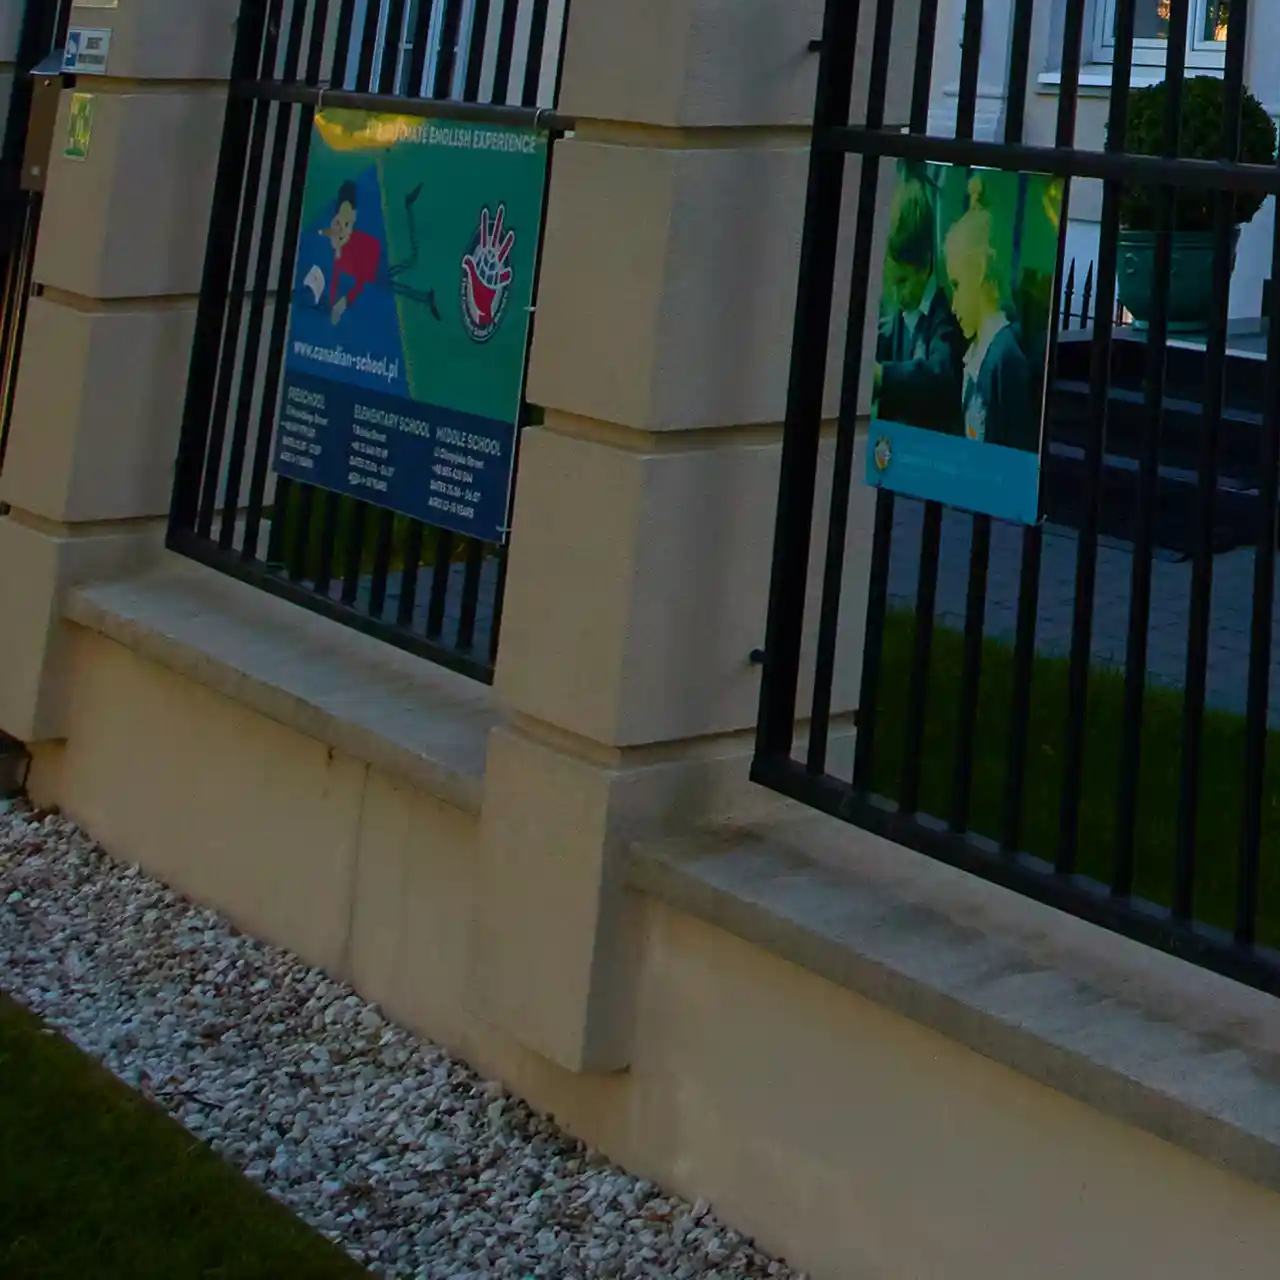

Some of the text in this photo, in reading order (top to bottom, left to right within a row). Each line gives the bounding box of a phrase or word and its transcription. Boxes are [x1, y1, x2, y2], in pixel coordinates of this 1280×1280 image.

[429, 127, 472, 150] ENGLISH
[473, 131, 537, 154] EXPERIENCE
[399, 416, 430, 438] SCHOOL
[436, 427, 501, 456] MIDDLE SCHOOL
